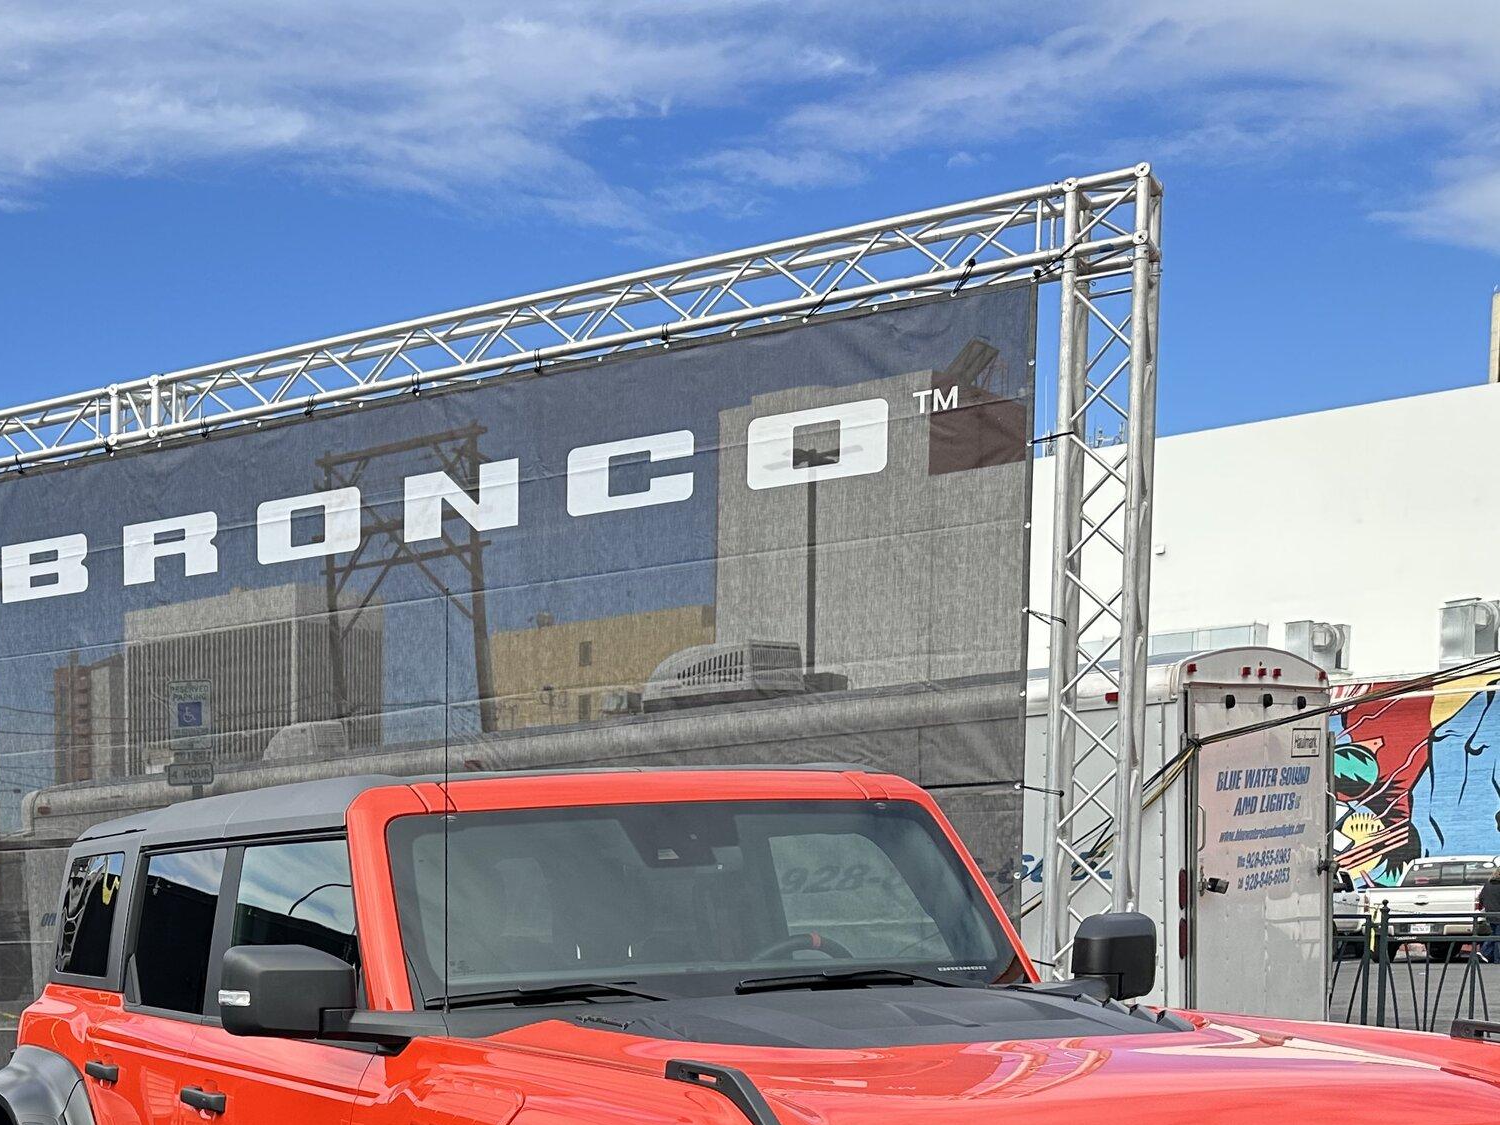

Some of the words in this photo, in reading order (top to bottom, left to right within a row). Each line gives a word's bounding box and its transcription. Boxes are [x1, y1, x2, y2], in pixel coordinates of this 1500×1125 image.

[2, 398, 888, 603] BRONCO
[912, 385, 958, 413] TM
[183, 769, 211, 778] HOUR
[1216, 770, 1242, 791] BLUE
[1245, 768, 1278, 788] WATER
[1279, 765, 1311, 785] SOUND
[1234, 797, 1258, 816] AND
[1260, 792, 1295, 813] LIGHTS
